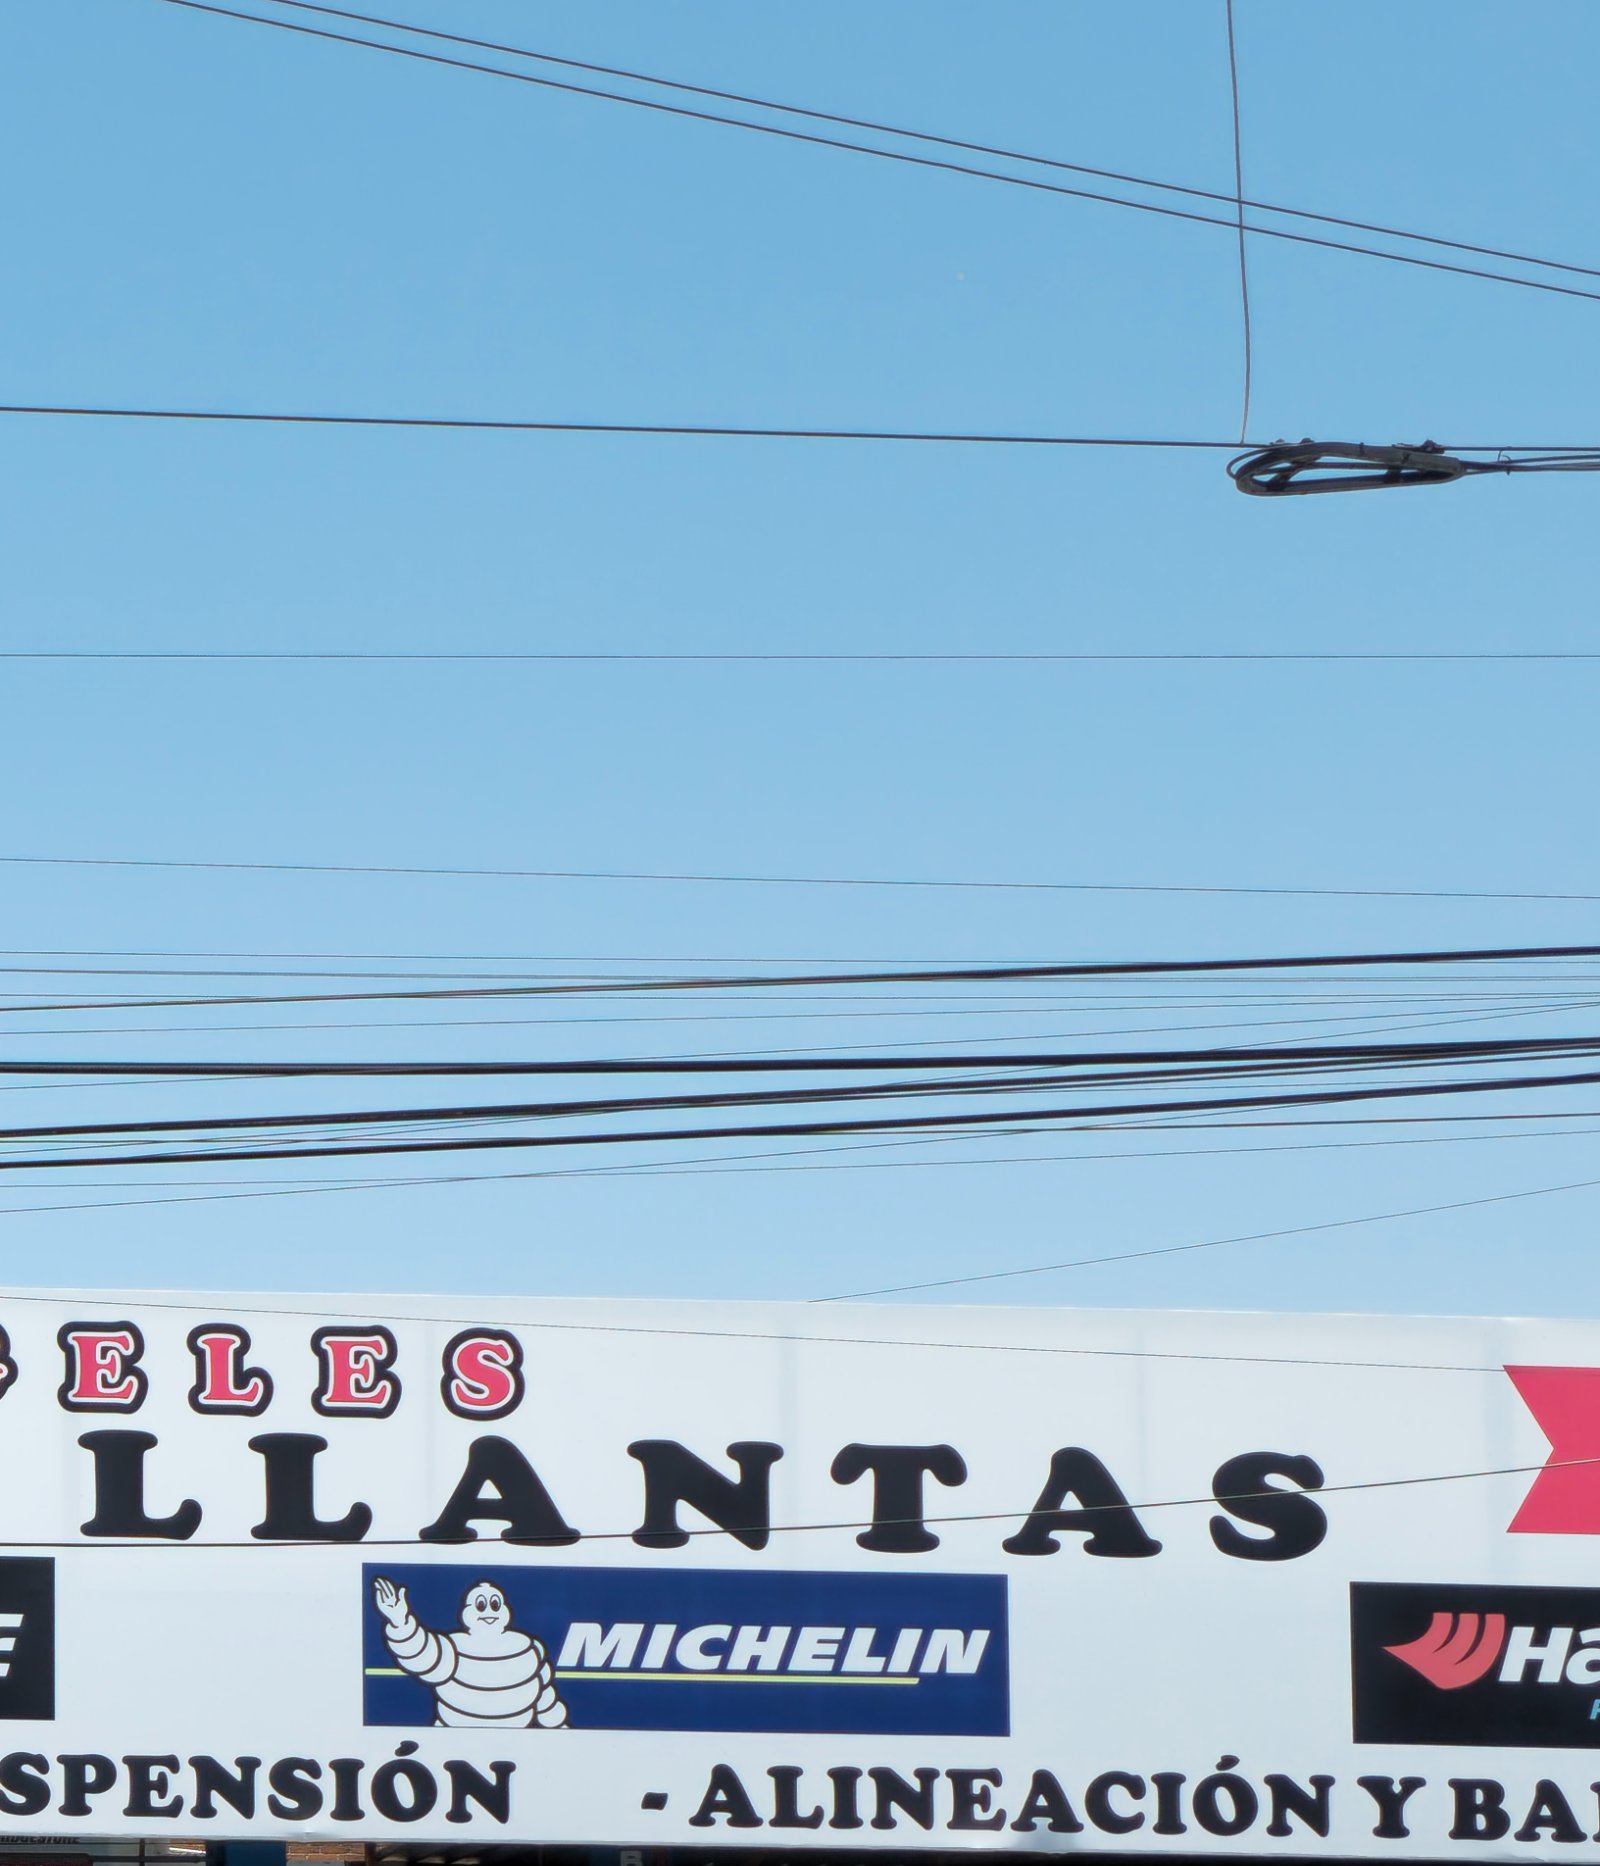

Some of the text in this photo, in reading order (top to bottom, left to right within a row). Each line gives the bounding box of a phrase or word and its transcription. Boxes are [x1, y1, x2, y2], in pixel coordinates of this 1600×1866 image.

[78, 1429, 1328, 1561] LLANTAS
[557, 1621, 990, 1675] MICHELIN
[688, 1755, 1334, 1837] ALINEACIÓN
[1356, 1775, 1426, 1839] Y
